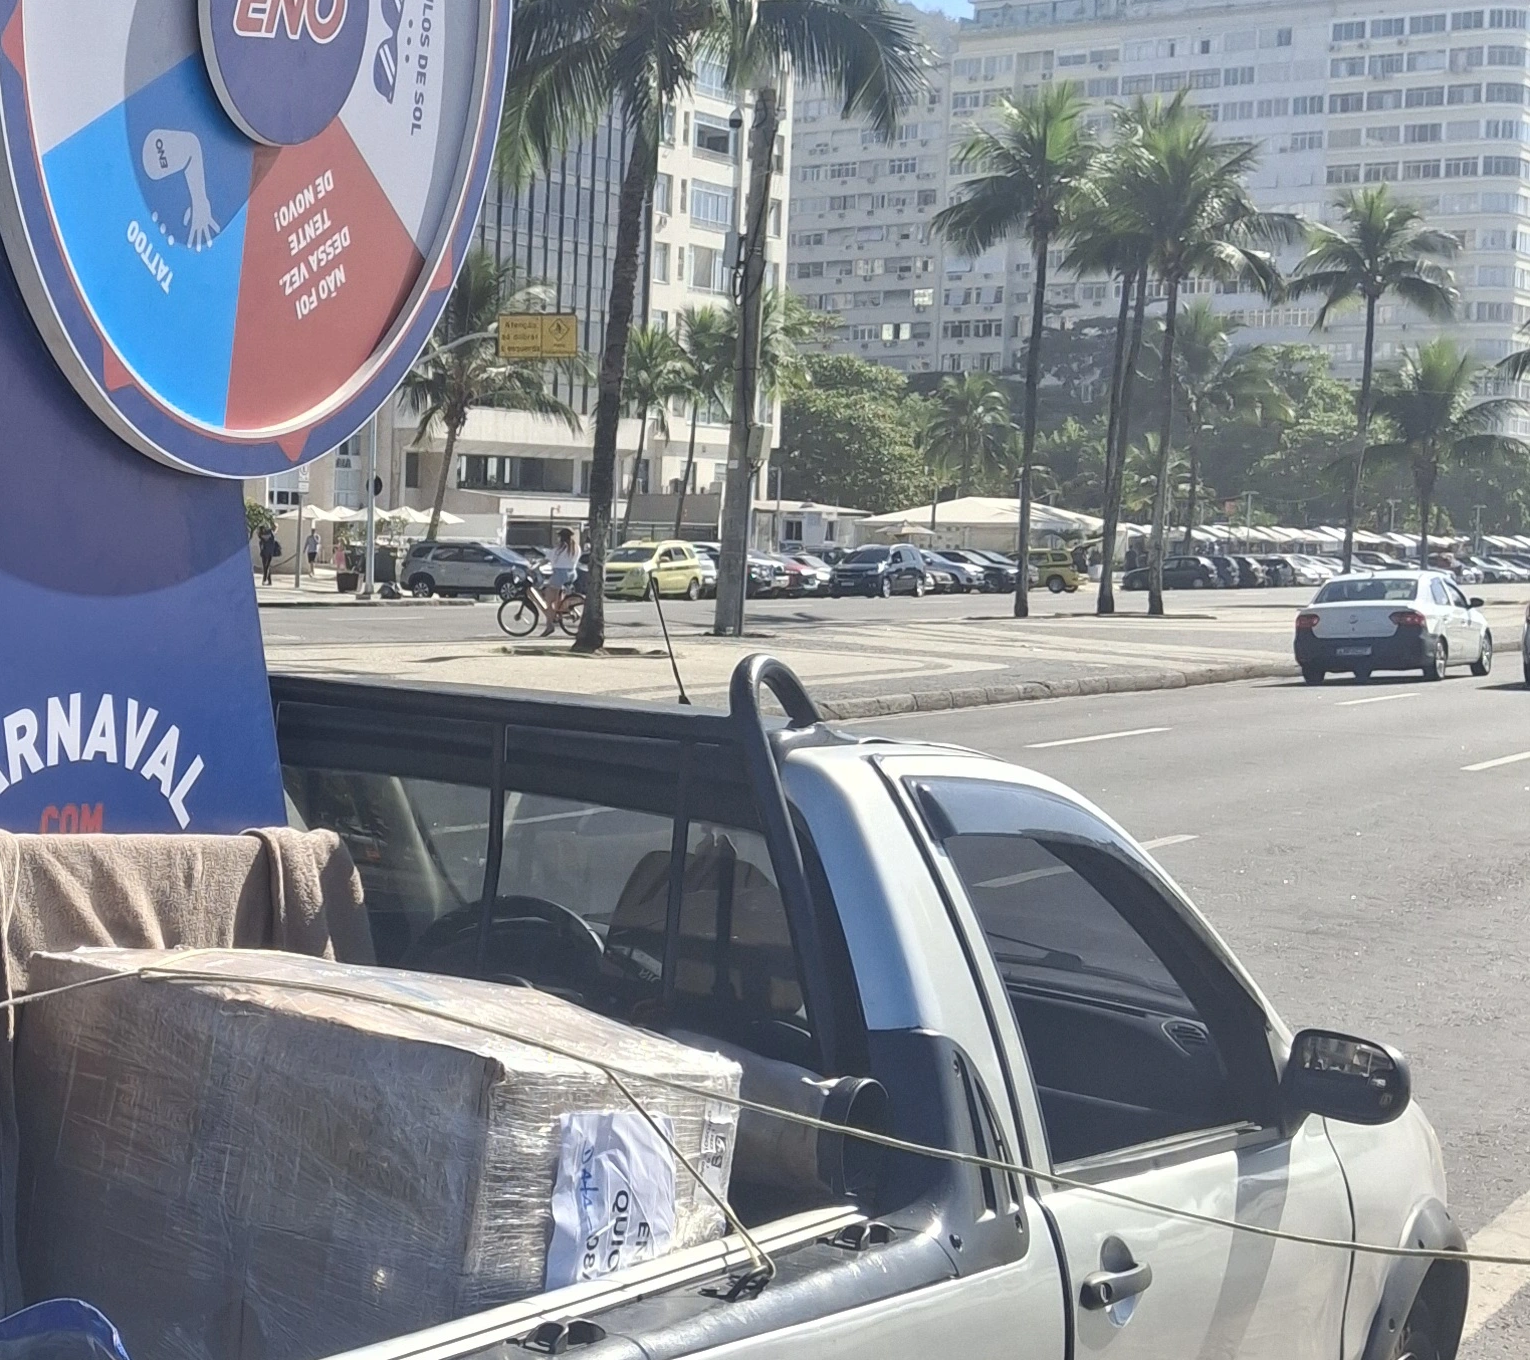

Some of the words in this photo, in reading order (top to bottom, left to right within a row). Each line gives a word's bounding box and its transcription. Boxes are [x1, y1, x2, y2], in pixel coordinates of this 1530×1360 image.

[416, 53, 429, 87] DE
[410, 89, 425, 136] SOL
[155, 138, 168, 169] ENO
[314, 169, 335, 200] DE
[274, 184, 315, 232] NOVO!
[287, 207, 332, 257] TENTE
[308, 225, 351, 272] DESSA
[127, 220, 174, 295] TATTOO
[278, 261, 309, 296] VEZ.
[318, 264, 346, 300] NÃO
[295, 287, 318, 320] FOI
